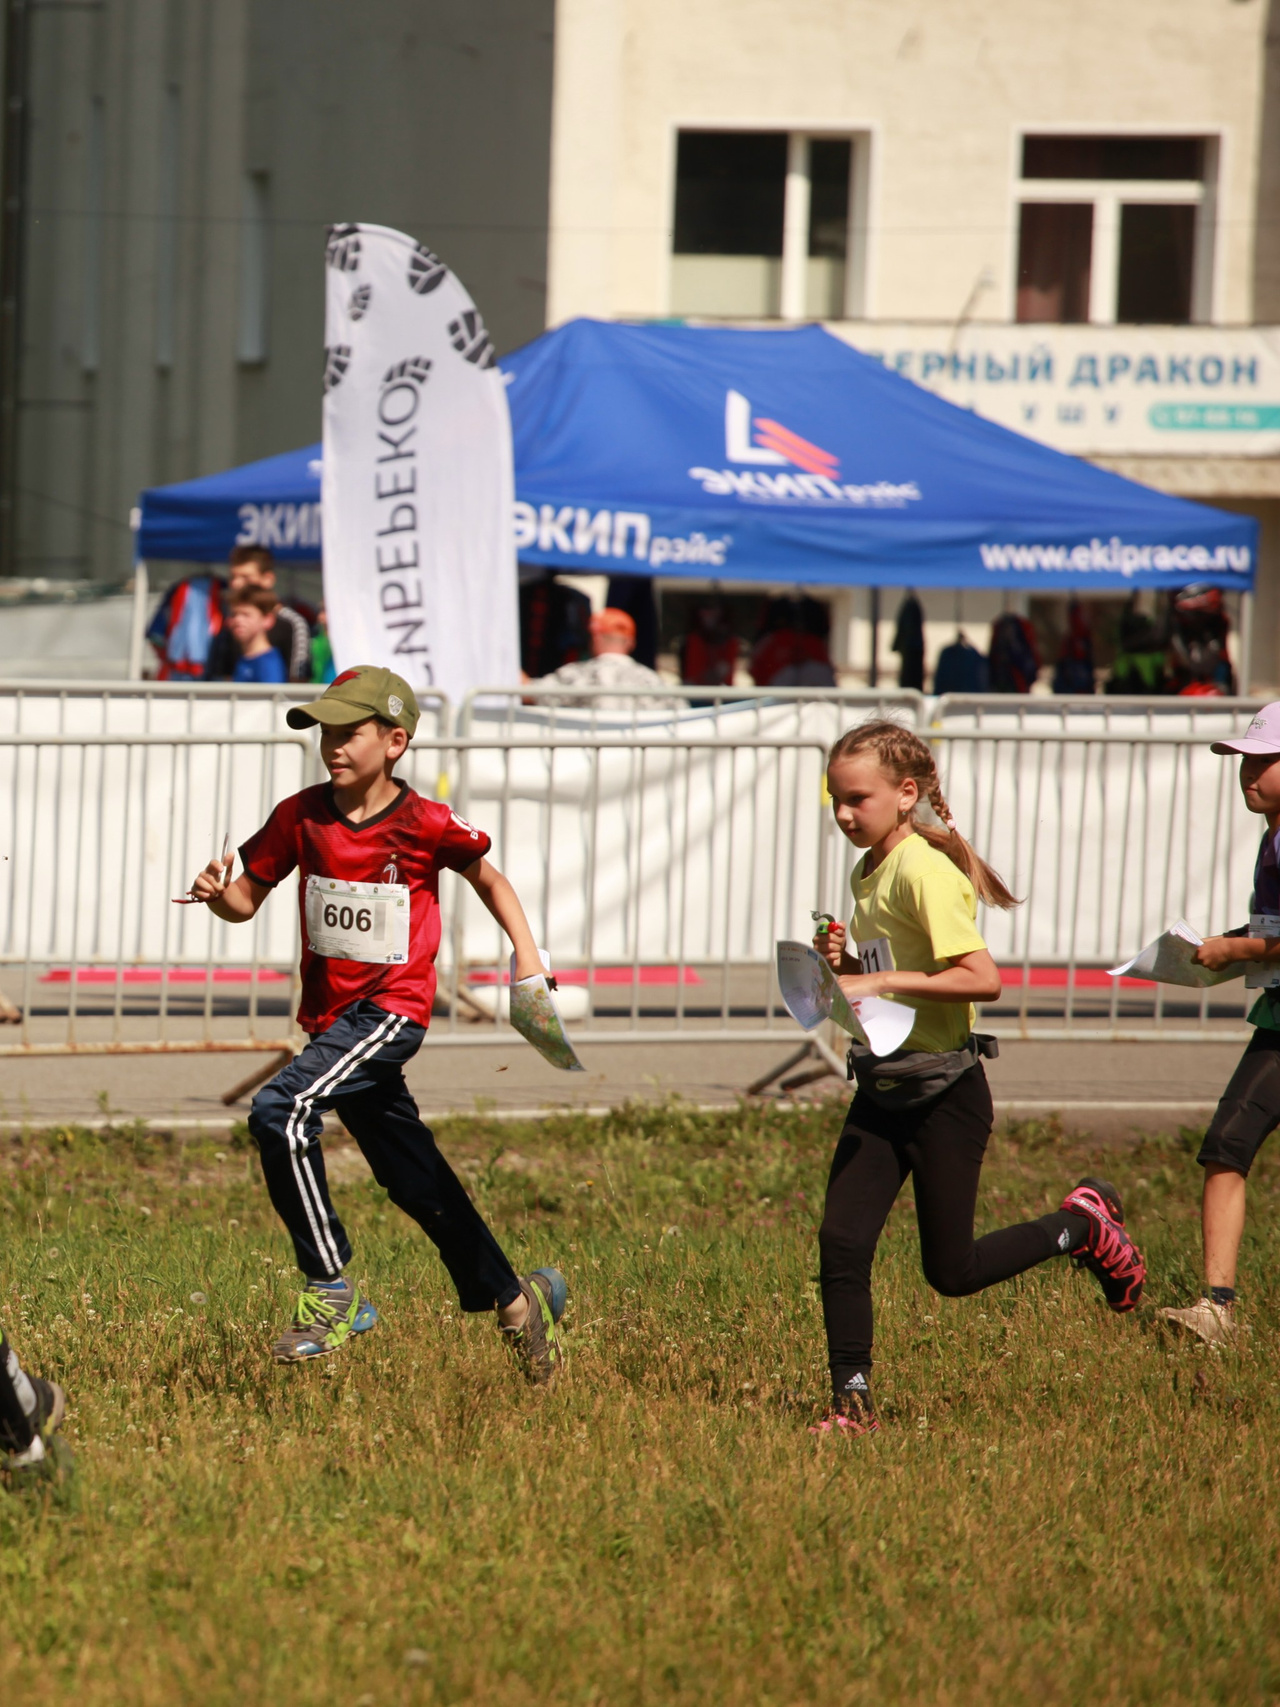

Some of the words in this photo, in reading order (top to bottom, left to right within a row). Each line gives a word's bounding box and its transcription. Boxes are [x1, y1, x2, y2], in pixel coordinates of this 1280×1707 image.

[875, 343, 1054, 381] ЕРНЫЙ
[1068, 354, 1258, 388] ДРАКОН
[979, 536, 1251, 578] www.ekiprace.ru
[324, 903, 372, 932] 606
[844, 1382, 868, 1390] adidas
